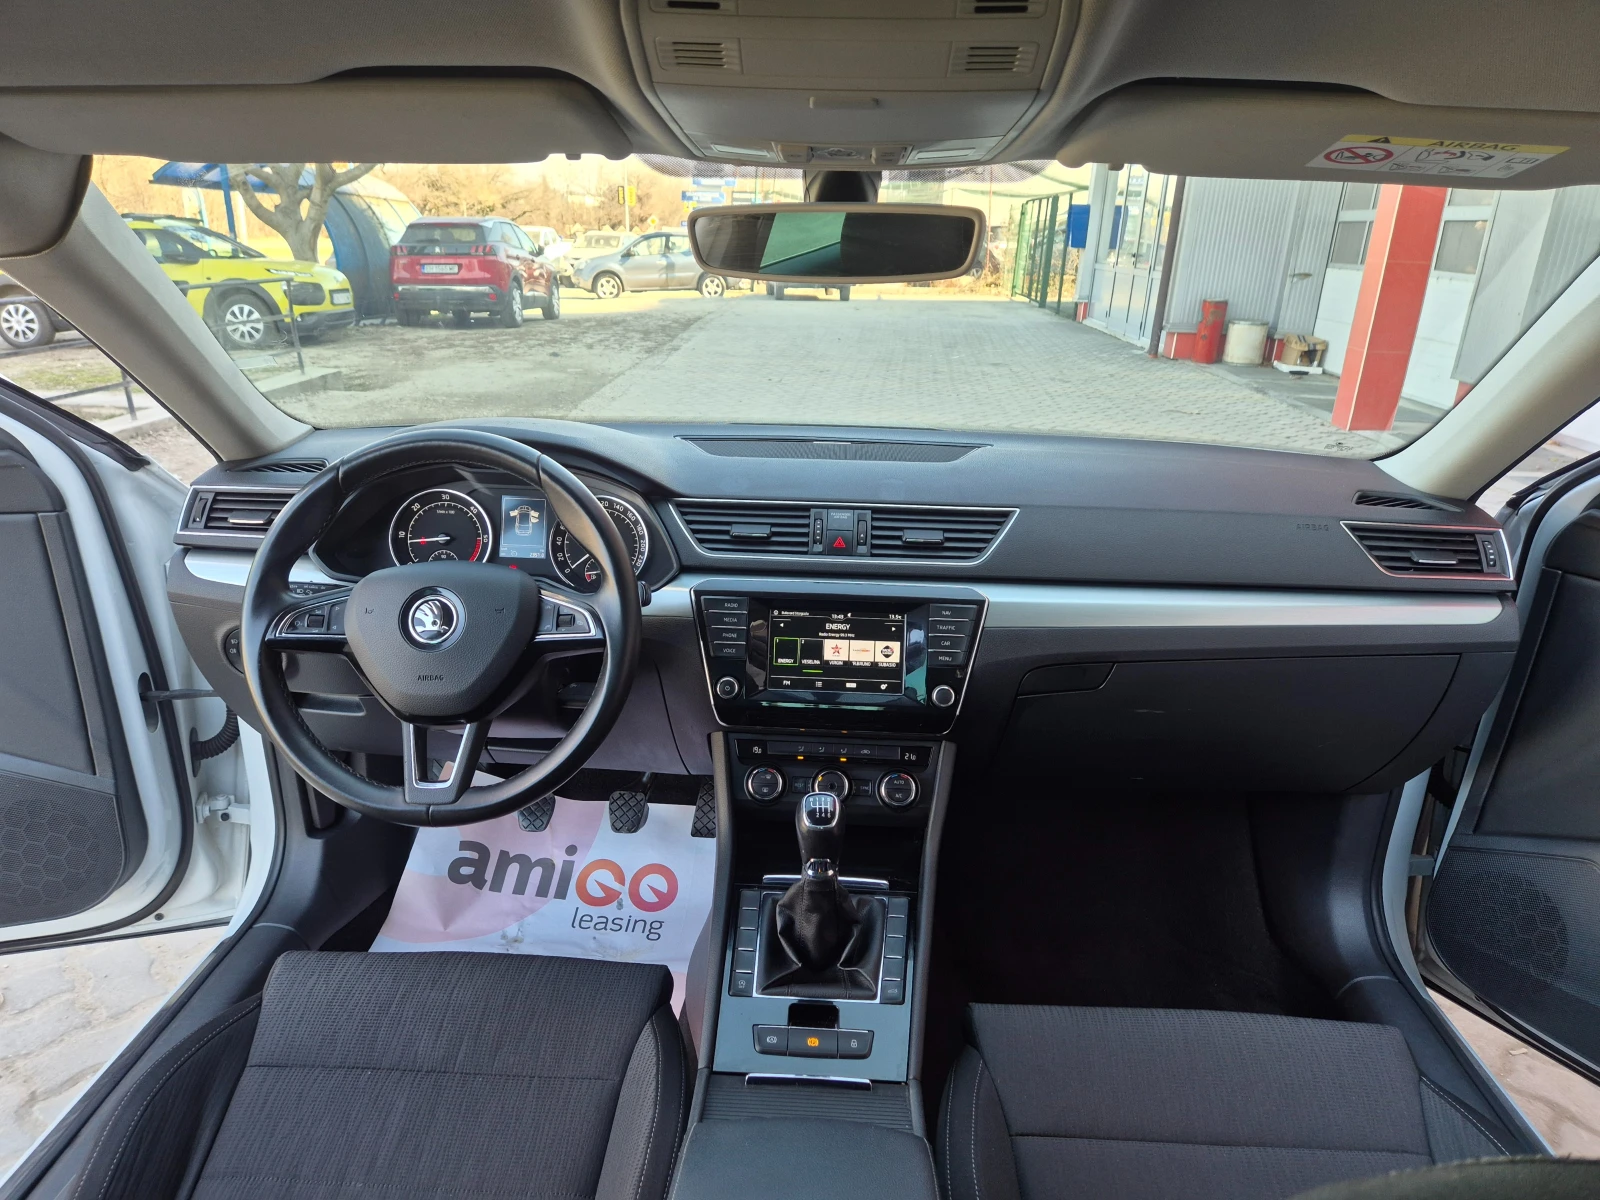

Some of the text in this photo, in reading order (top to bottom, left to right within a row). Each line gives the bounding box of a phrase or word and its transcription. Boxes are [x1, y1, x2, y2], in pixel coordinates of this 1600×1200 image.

[1428, 140, 1522, 152] AIRBAG
[411, 502, 421, 511] 20
[613, 503, 624, 512] 140
[626, 511, 636, 521] 160
[483, 534, 488, 543] 50
[556, 537, 562, 545] 40
[557, 552, 564, 561] 20
[571, 906, 665, 941] leasing
